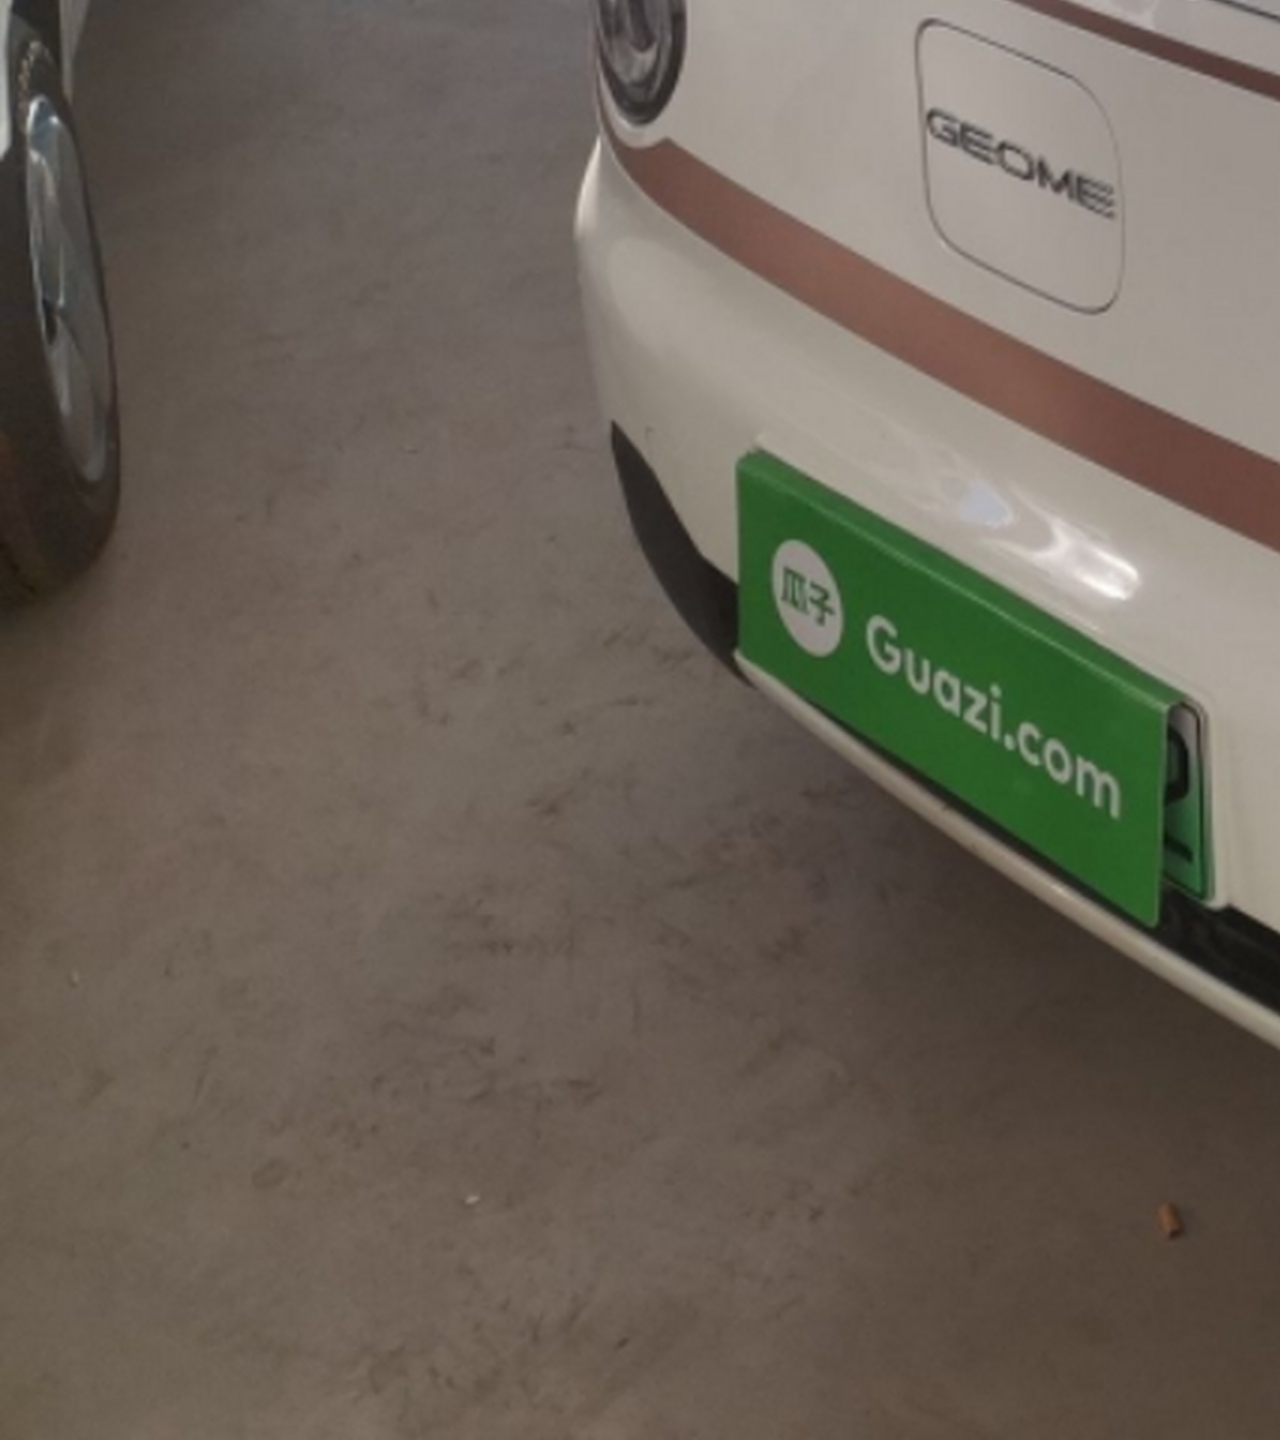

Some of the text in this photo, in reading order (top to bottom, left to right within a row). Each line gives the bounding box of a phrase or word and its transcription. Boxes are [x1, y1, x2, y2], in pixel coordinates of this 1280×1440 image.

[926, 107, 1115, 218] GEOME
[781, 566, 836, 627] 瓜子
[866, 615, 1121, 819] Guazi.com
